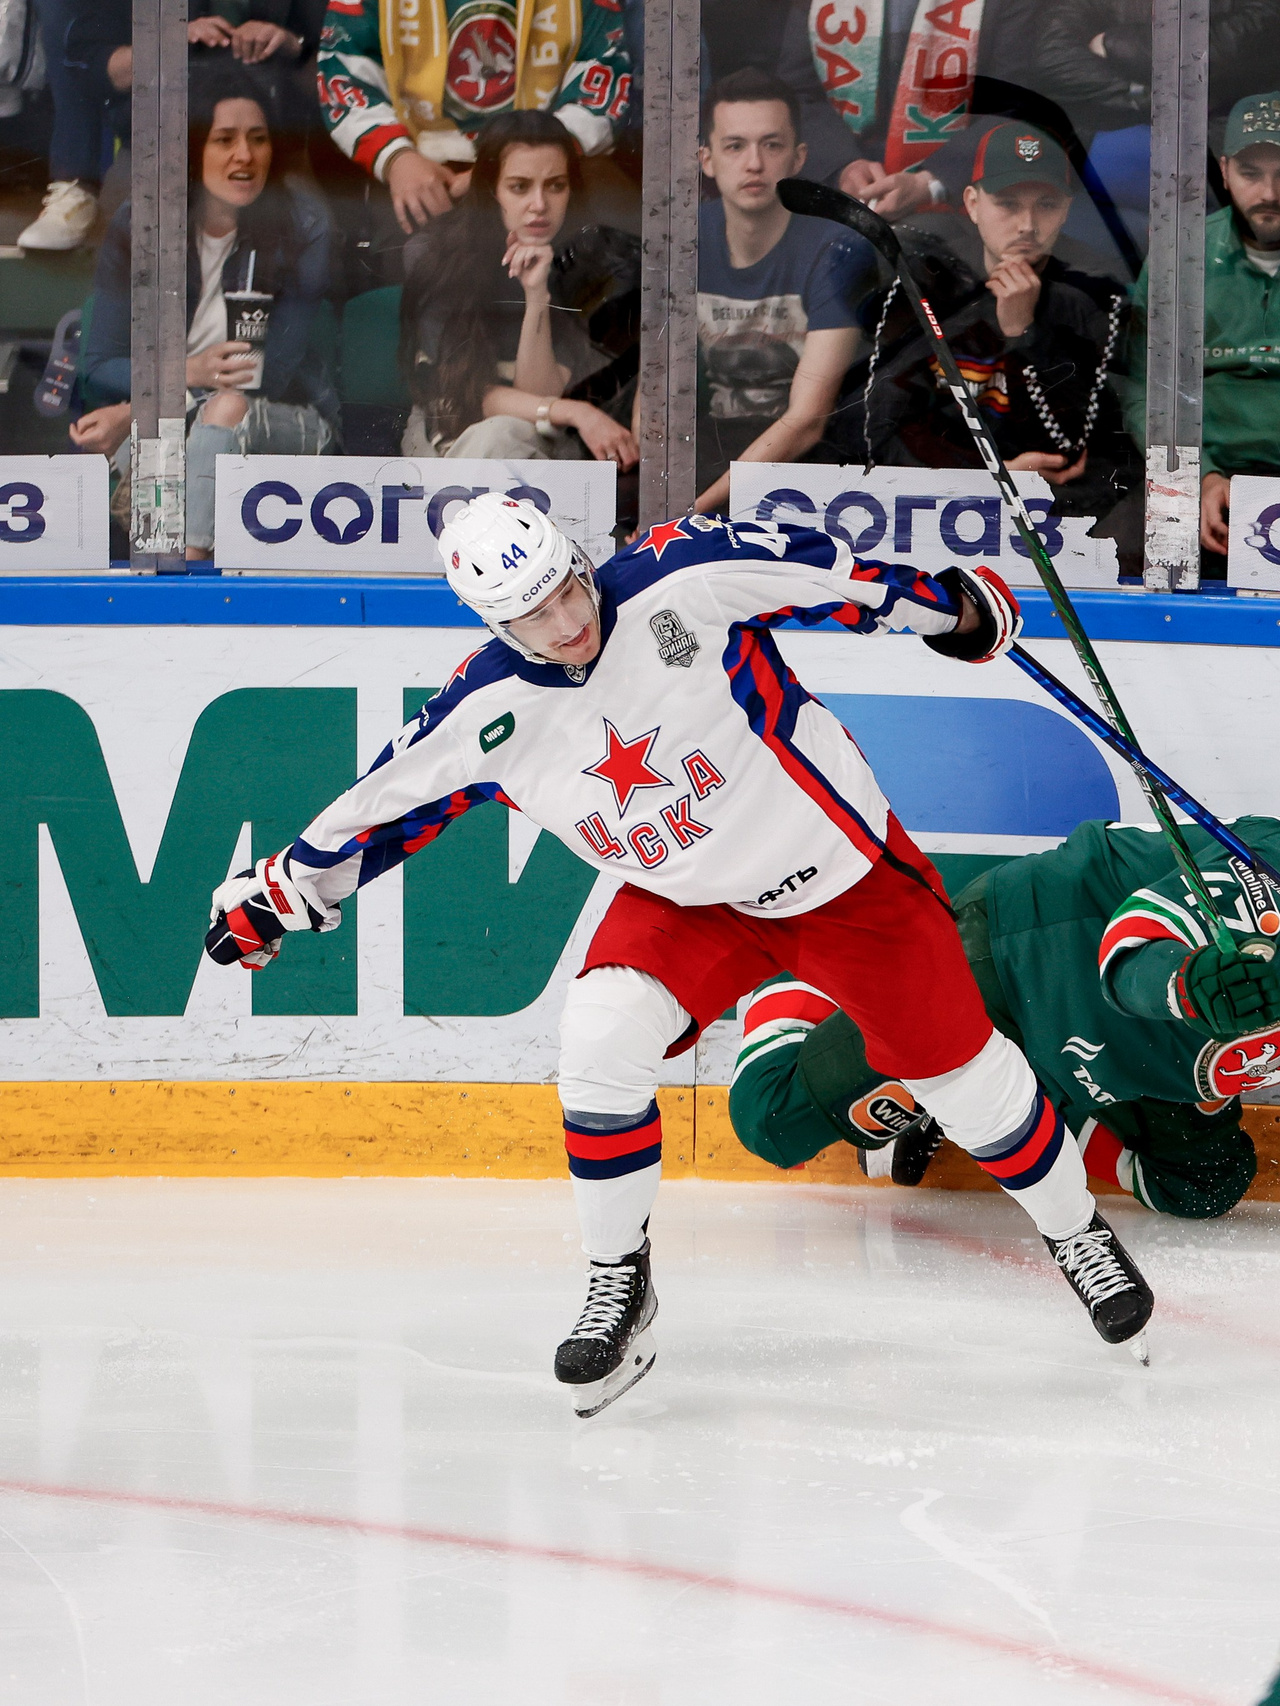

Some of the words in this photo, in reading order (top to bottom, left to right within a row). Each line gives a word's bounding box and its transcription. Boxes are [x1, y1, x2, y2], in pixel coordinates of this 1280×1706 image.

[921, 301, 943, 338] CCM
[1203, 345, 1257, 359] TOMMY
[501, 543, 527, 570] 44
[660, 633, 697, 660] ФИНАЛ
[484, 724, 505, 743] МИР
[1131, 760, 1147, 774] DIETZ
[575, 748, 727, 870] ЦСКА
